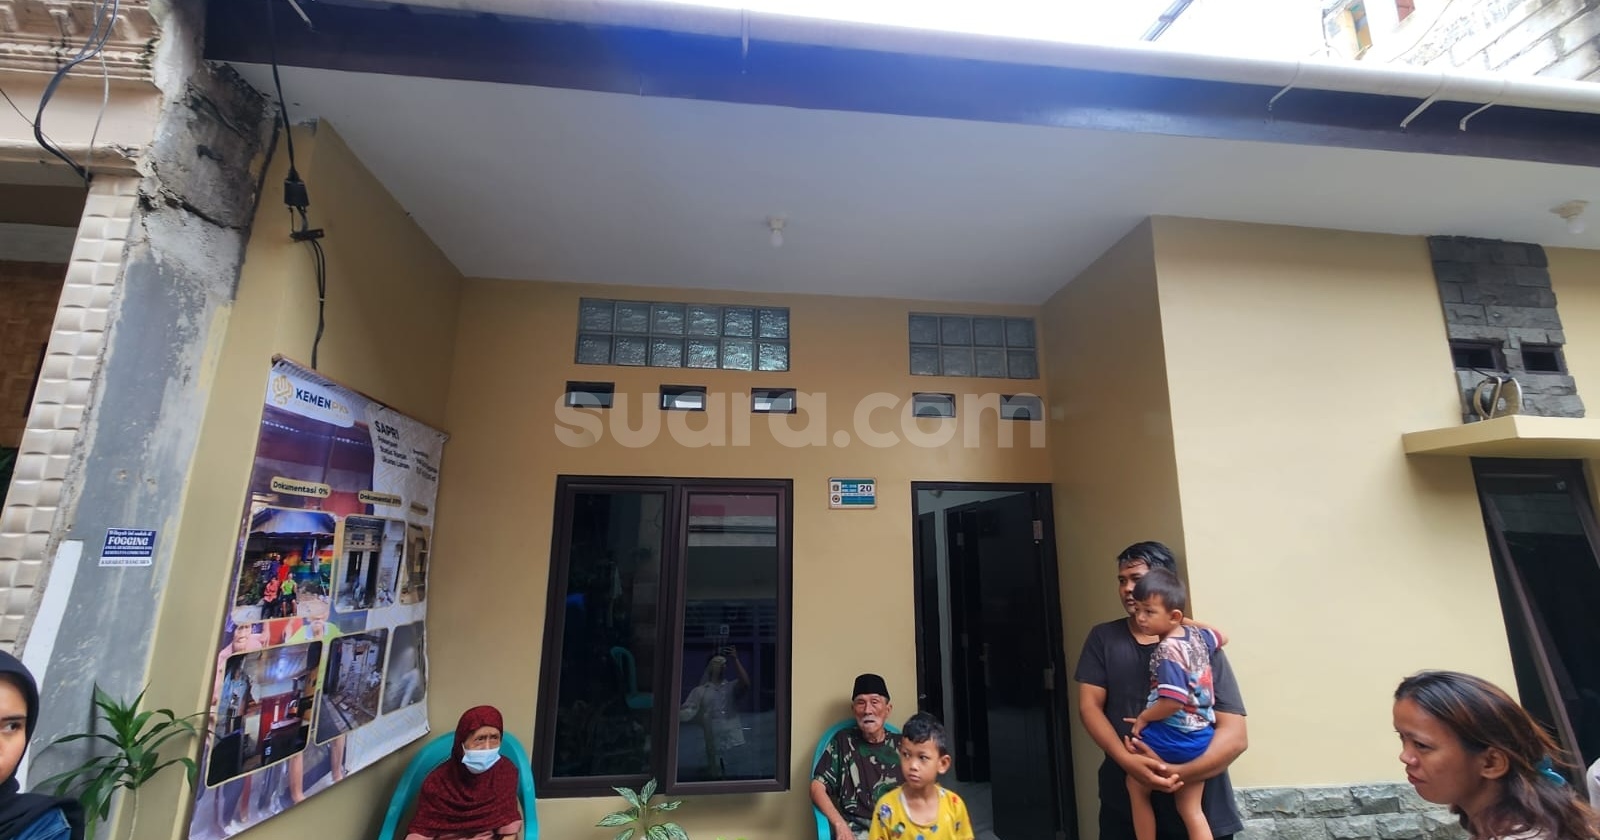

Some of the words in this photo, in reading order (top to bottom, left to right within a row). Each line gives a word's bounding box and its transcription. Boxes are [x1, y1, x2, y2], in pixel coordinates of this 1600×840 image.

[374, 420, 400, 440] SAPRI
[273, 480, 317, 494] Dokumentasi
[318, 487, 329, 497] 0%
[859, 484, 872, 493] 20
[108, 536, 149, 545] FOGGING
